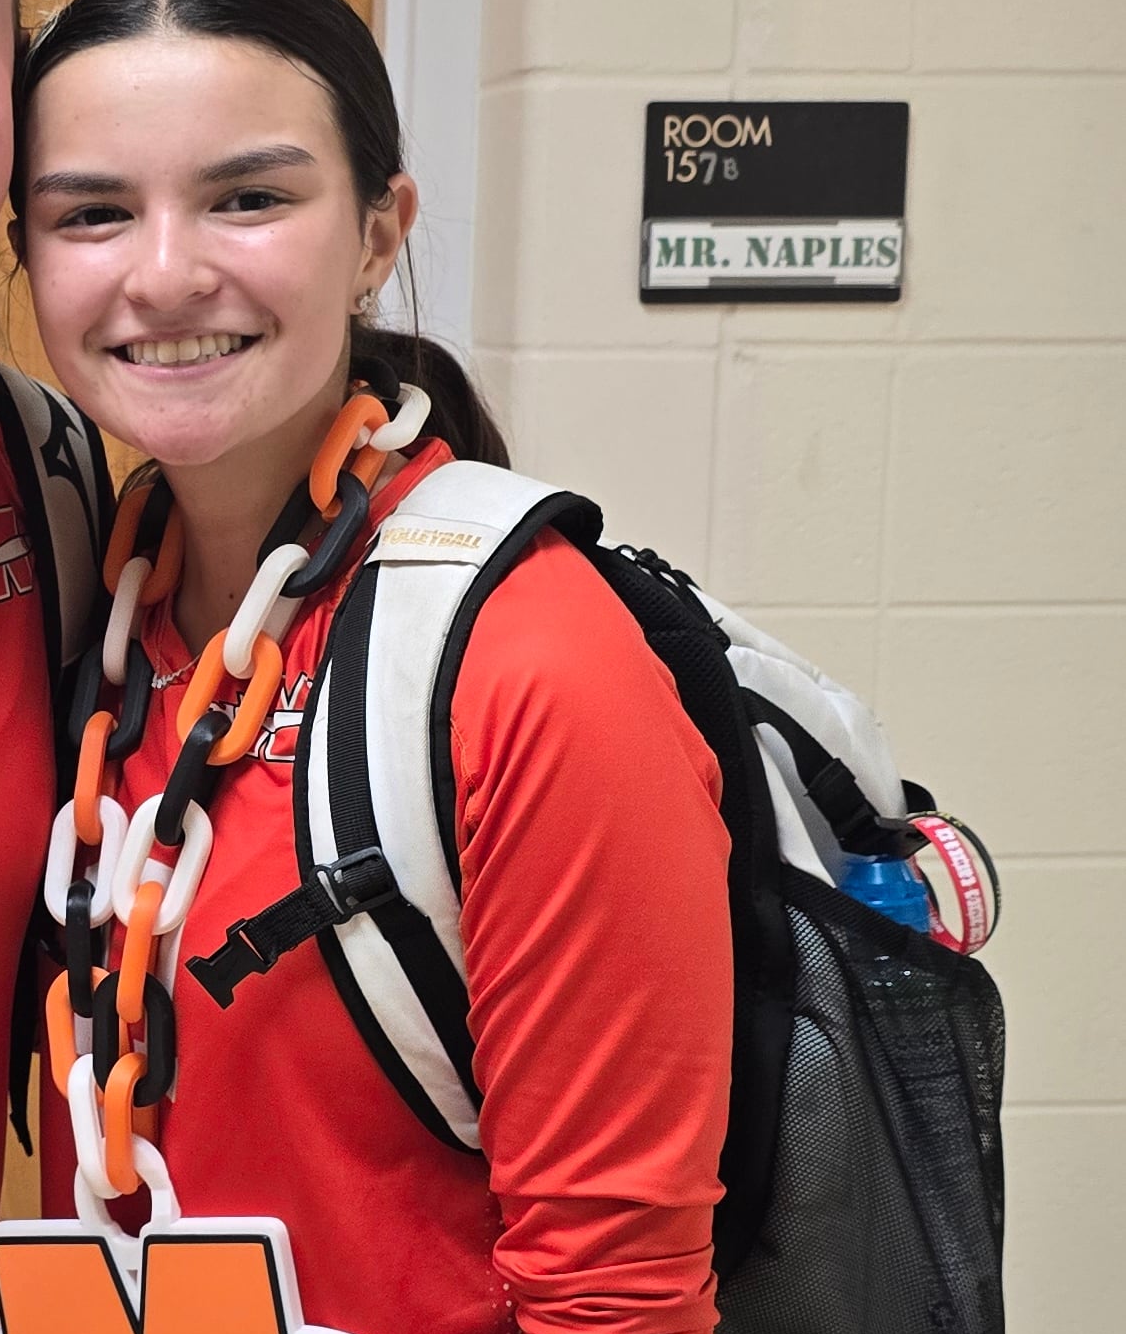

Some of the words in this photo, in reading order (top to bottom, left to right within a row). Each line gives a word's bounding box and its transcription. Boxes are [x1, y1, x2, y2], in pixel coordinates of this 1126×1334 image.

[664, 114, 772, 148] ROOM
[655, 236, 731, 268] MR.
[745, 235, 898, 268] NAPLES
[382, 527, 482, 549] VOLLEYBALL
